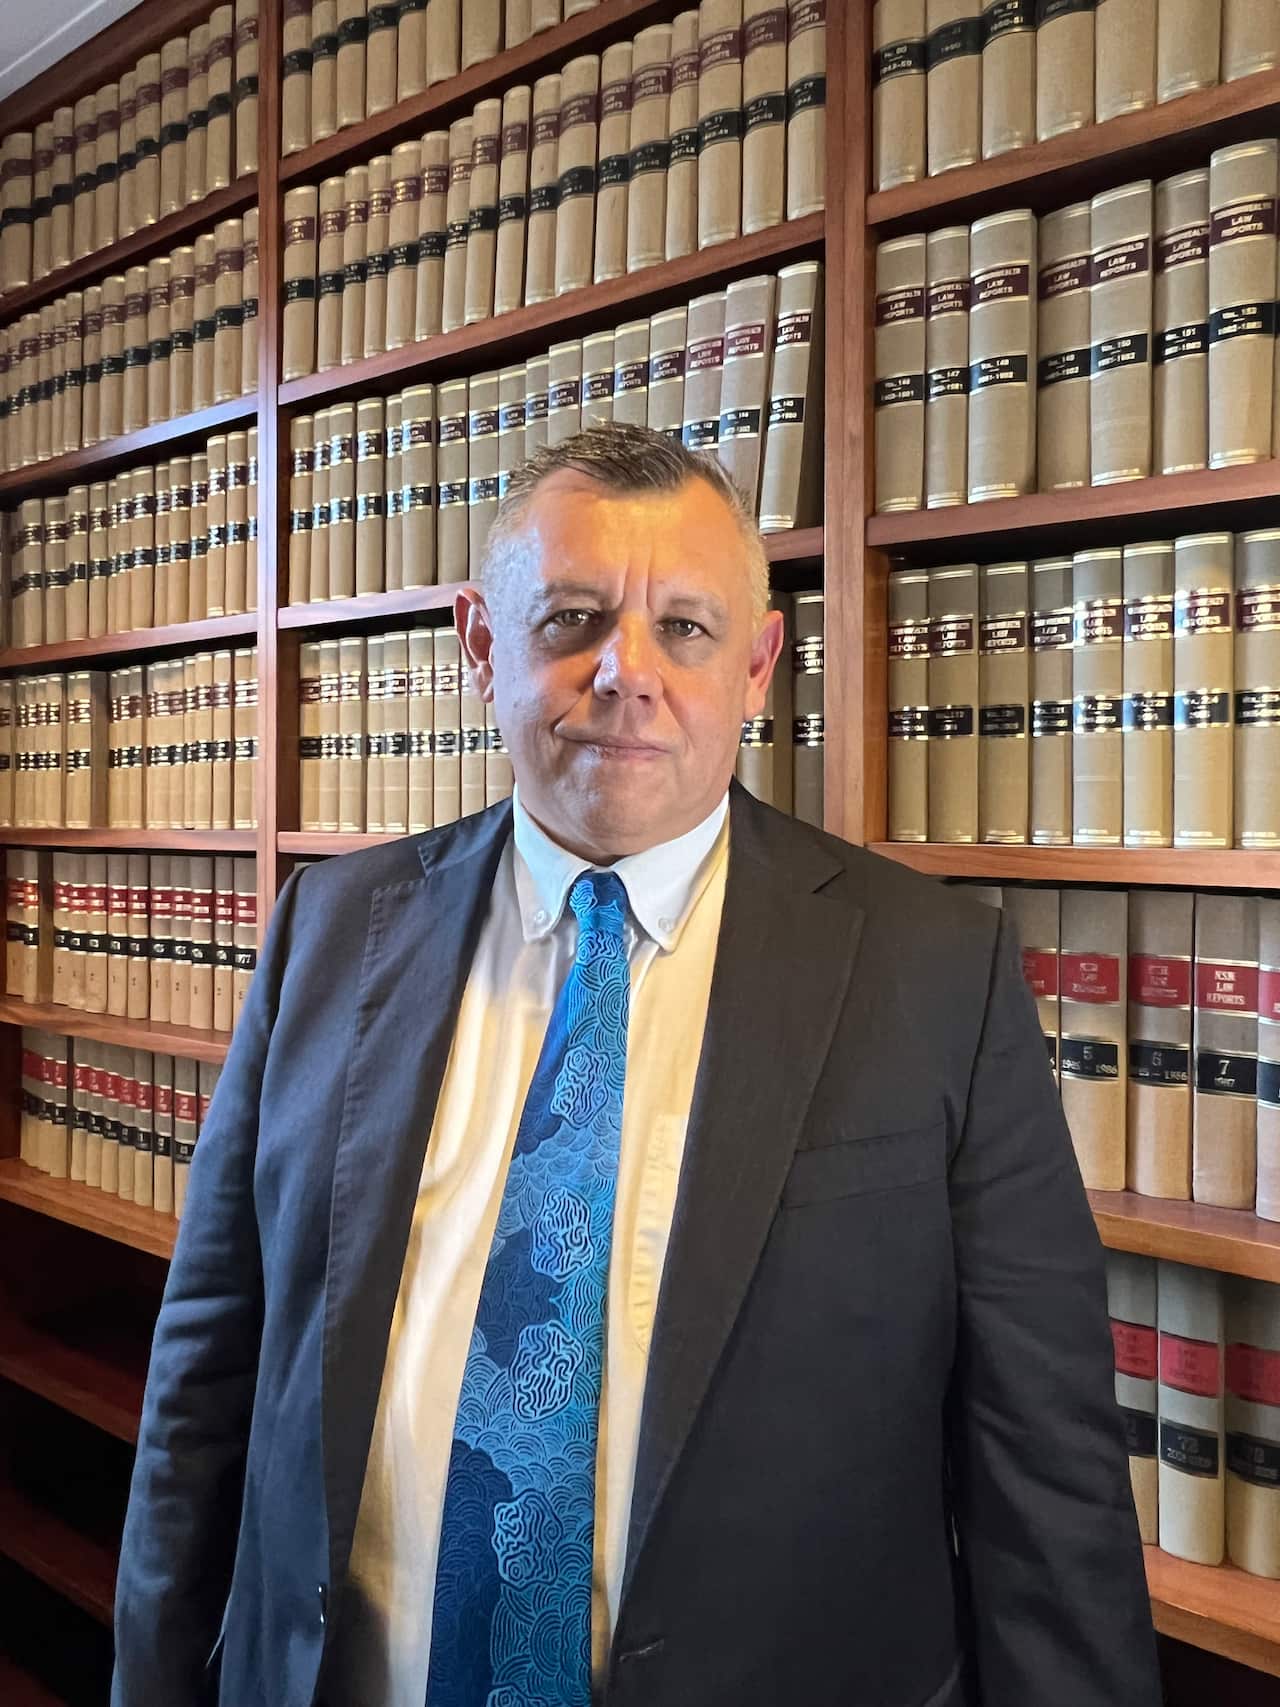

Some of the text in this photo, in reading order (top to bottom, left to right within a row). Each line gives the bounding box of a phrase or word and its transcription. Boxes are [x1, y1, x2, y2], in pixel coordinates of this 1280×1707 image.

[1231, 214, 1254, 226] LAW
[1172, 241, 1192, 252] LAW
[1108, 255, 1127, 267] LAW
[987, 279, 1005, 289] LAW
[938, 293, 955, 302] LAW
[1216, 981, 1234, 992] LAW
[1206, 993, 1245, 1006] REPORTS
[1083, 1046, 1093, 1060] 5
[1218, 1060, 1230, 1075] 7
